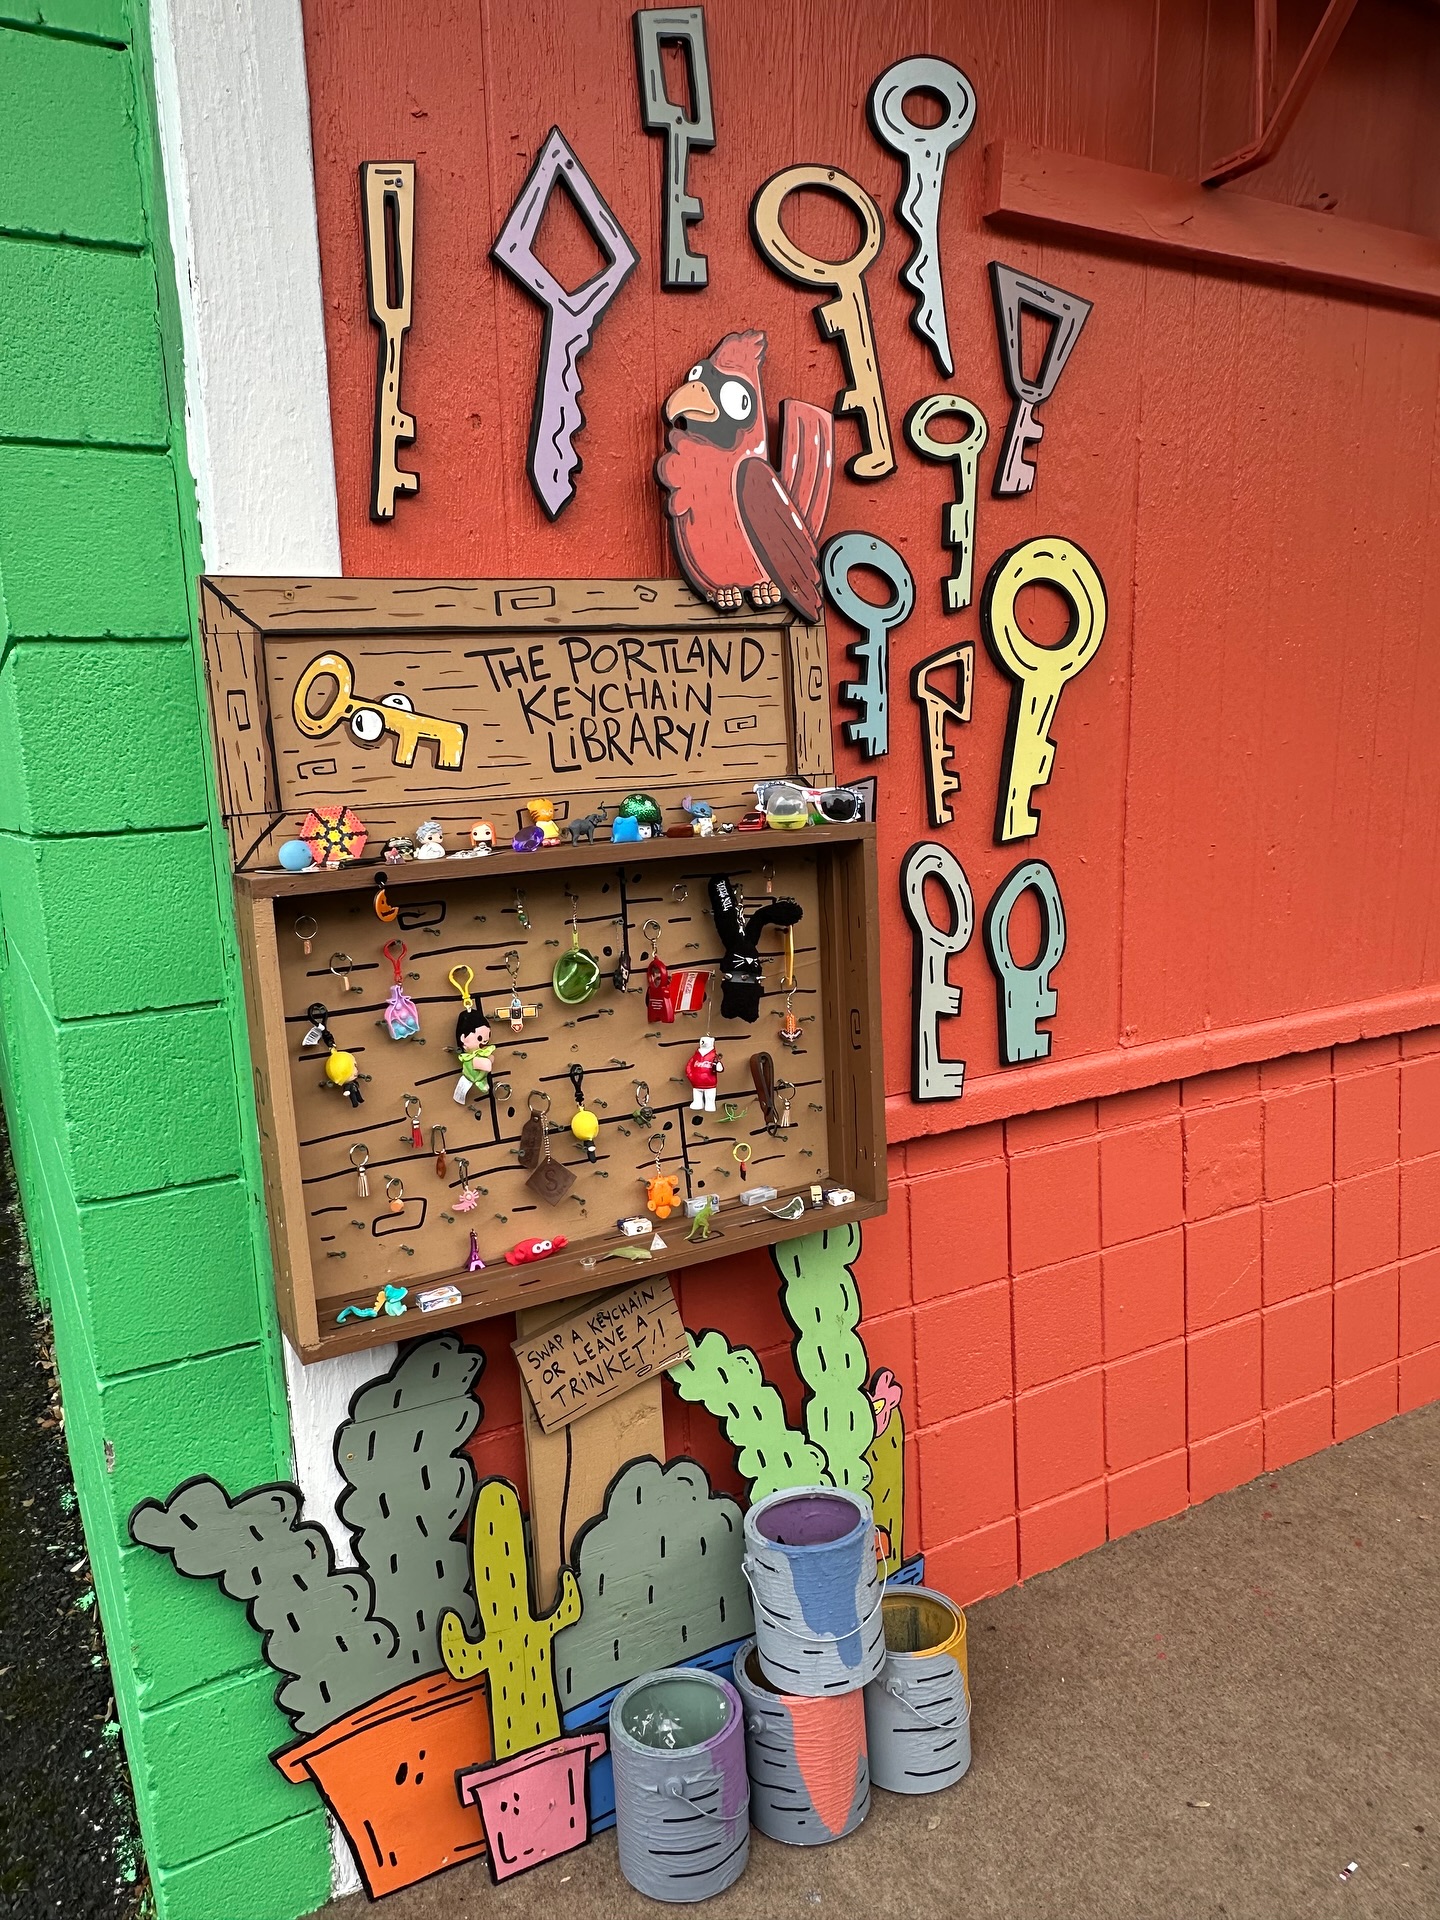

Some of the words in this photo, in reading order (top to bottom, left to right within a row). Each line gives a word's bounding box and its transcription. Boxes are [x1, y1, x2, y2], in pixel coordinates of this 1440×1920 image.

[464, 644, 551, 692] THE
[559, 636, 765, 684] PORTLAND
[545, 1169, 558, 1192] S
[527, 1334, 565, 1370] SWAP
[571, 1329, 583, 1344] A
[542, 1361, 566, 1384] OR
[573, 1324, 627, 1366] LEAVE
[637, 1315, 648, 1332] A
